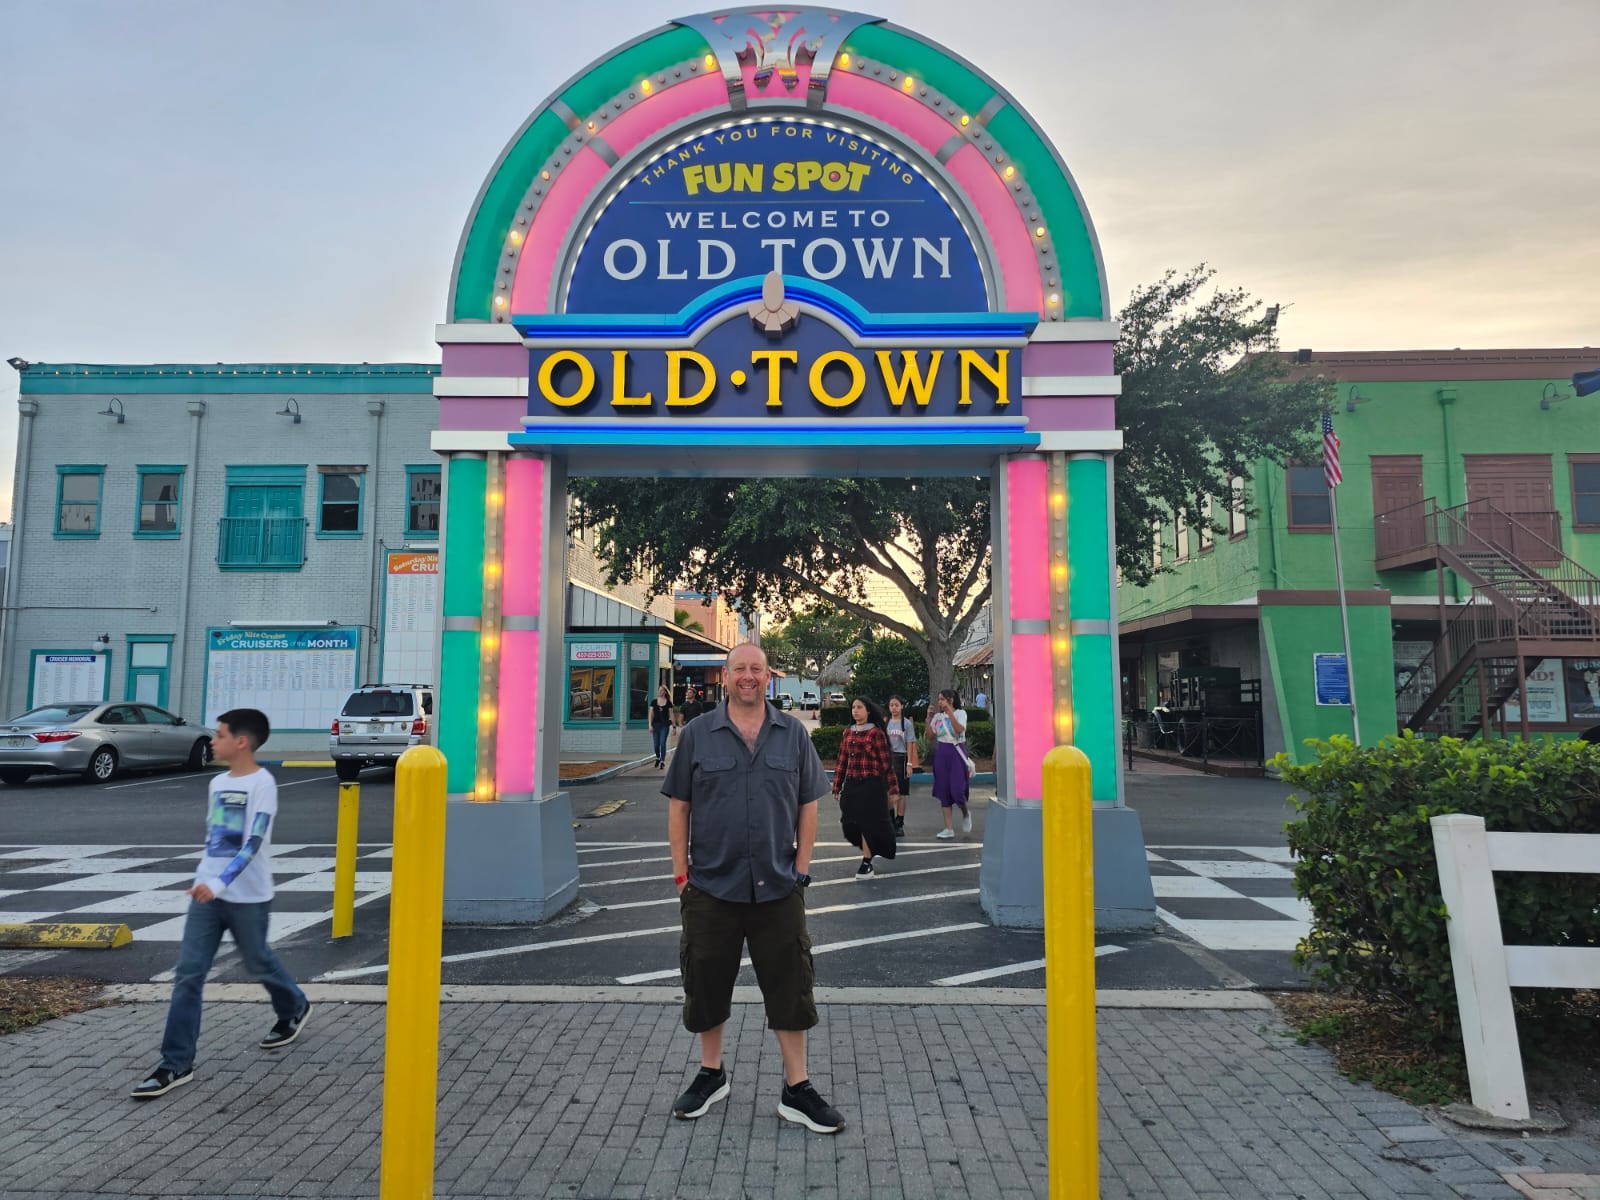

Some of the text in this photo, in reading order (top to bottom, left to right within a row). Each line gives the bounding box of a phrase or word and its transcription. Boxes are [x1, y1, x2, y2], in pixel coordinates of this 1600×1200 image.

[641, 126, 913, 186] THANK YOU FOR VISITING
[682, 160, 872, 196] FUN SPOT
[665, 209, 890, 230] WELCOME TO
[603, 237, 952, 281] OLD TOWN
[537, 348, 1011, 408] OLD TOWN
[217, 631, 243, 646] Friday
[244, 631, 260, 639] Nite
[231, 639, 289, 649] CRUISERS
[307, 639, 348, 648] MONTH
